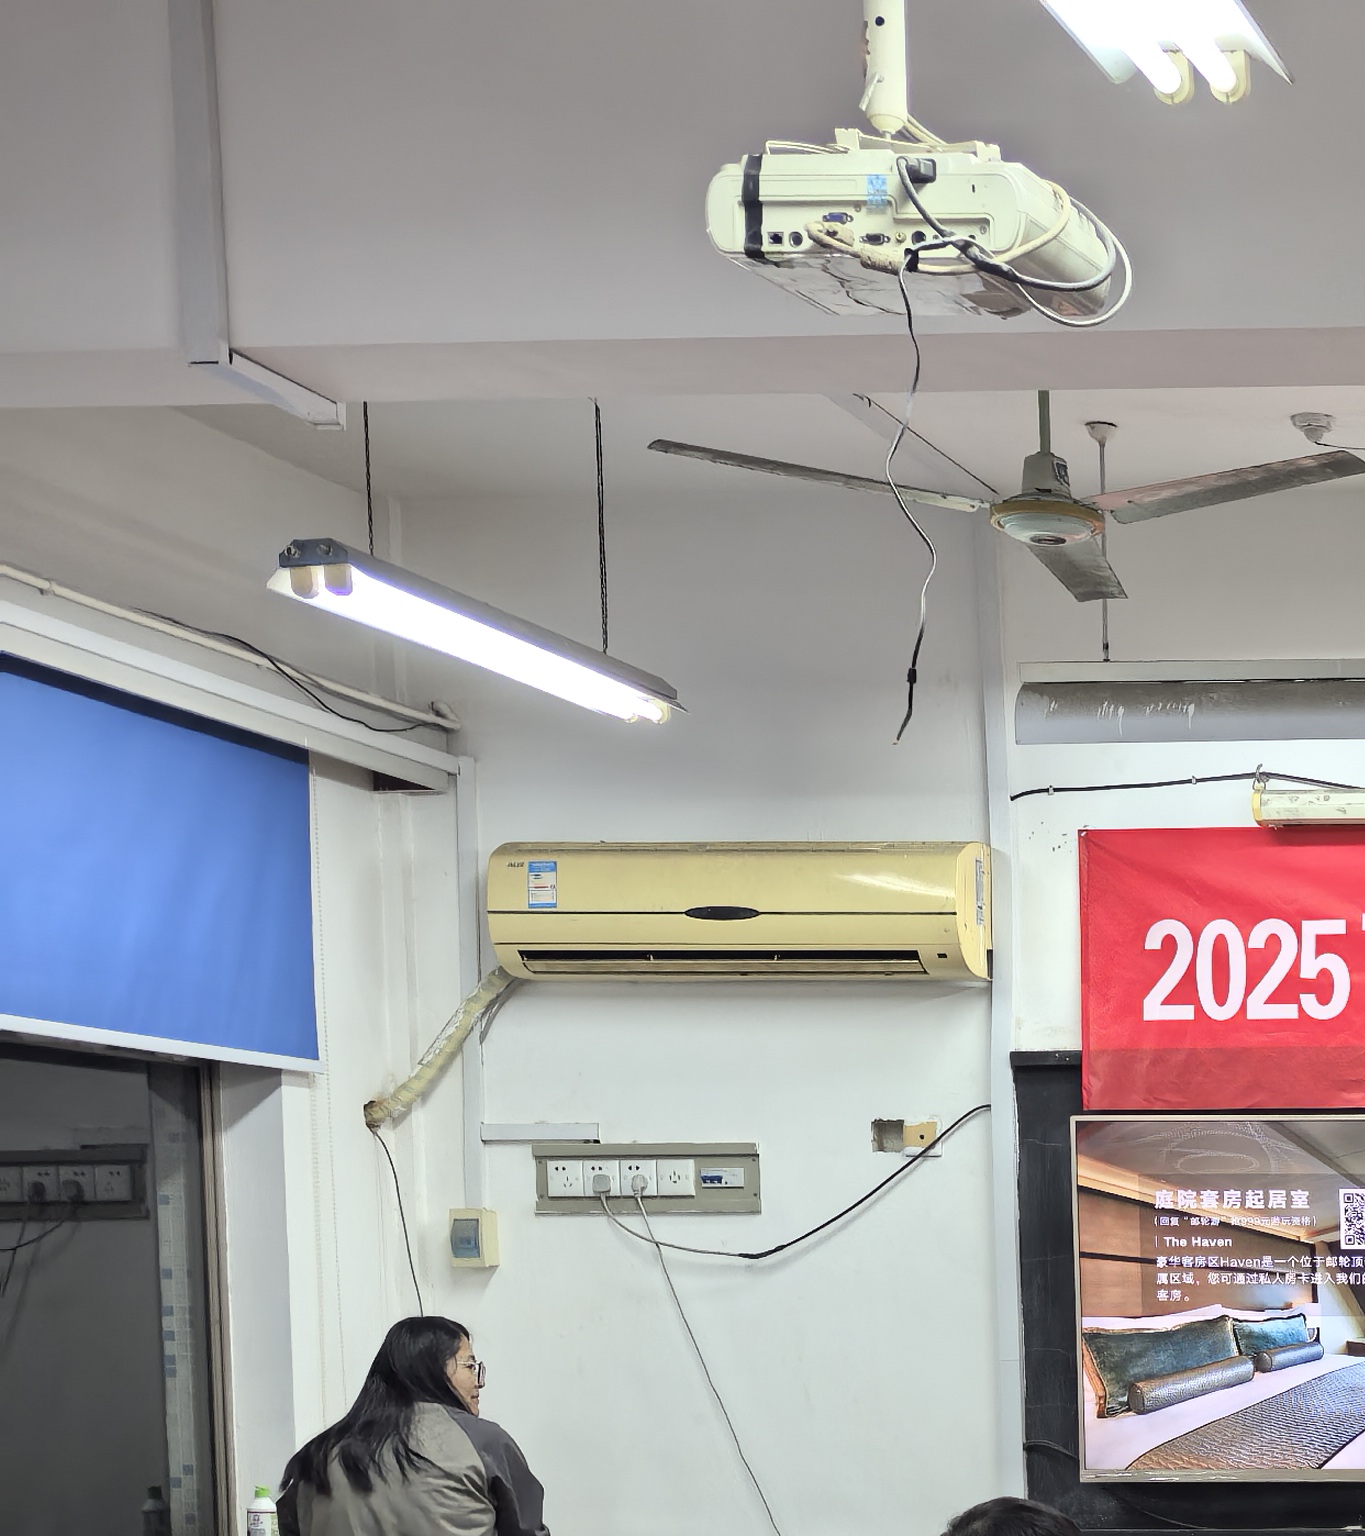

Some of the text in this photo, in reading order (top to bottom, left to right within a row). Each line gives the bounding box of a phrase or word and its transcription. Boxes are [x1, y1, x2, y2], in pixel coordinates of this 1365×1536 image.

[1155, 1190, 1310, 1209] 庭院套房起居室
[1163, 1236, 1233, 1247] The Haven
[1156, 1289, 1190, 1302] 客房。
